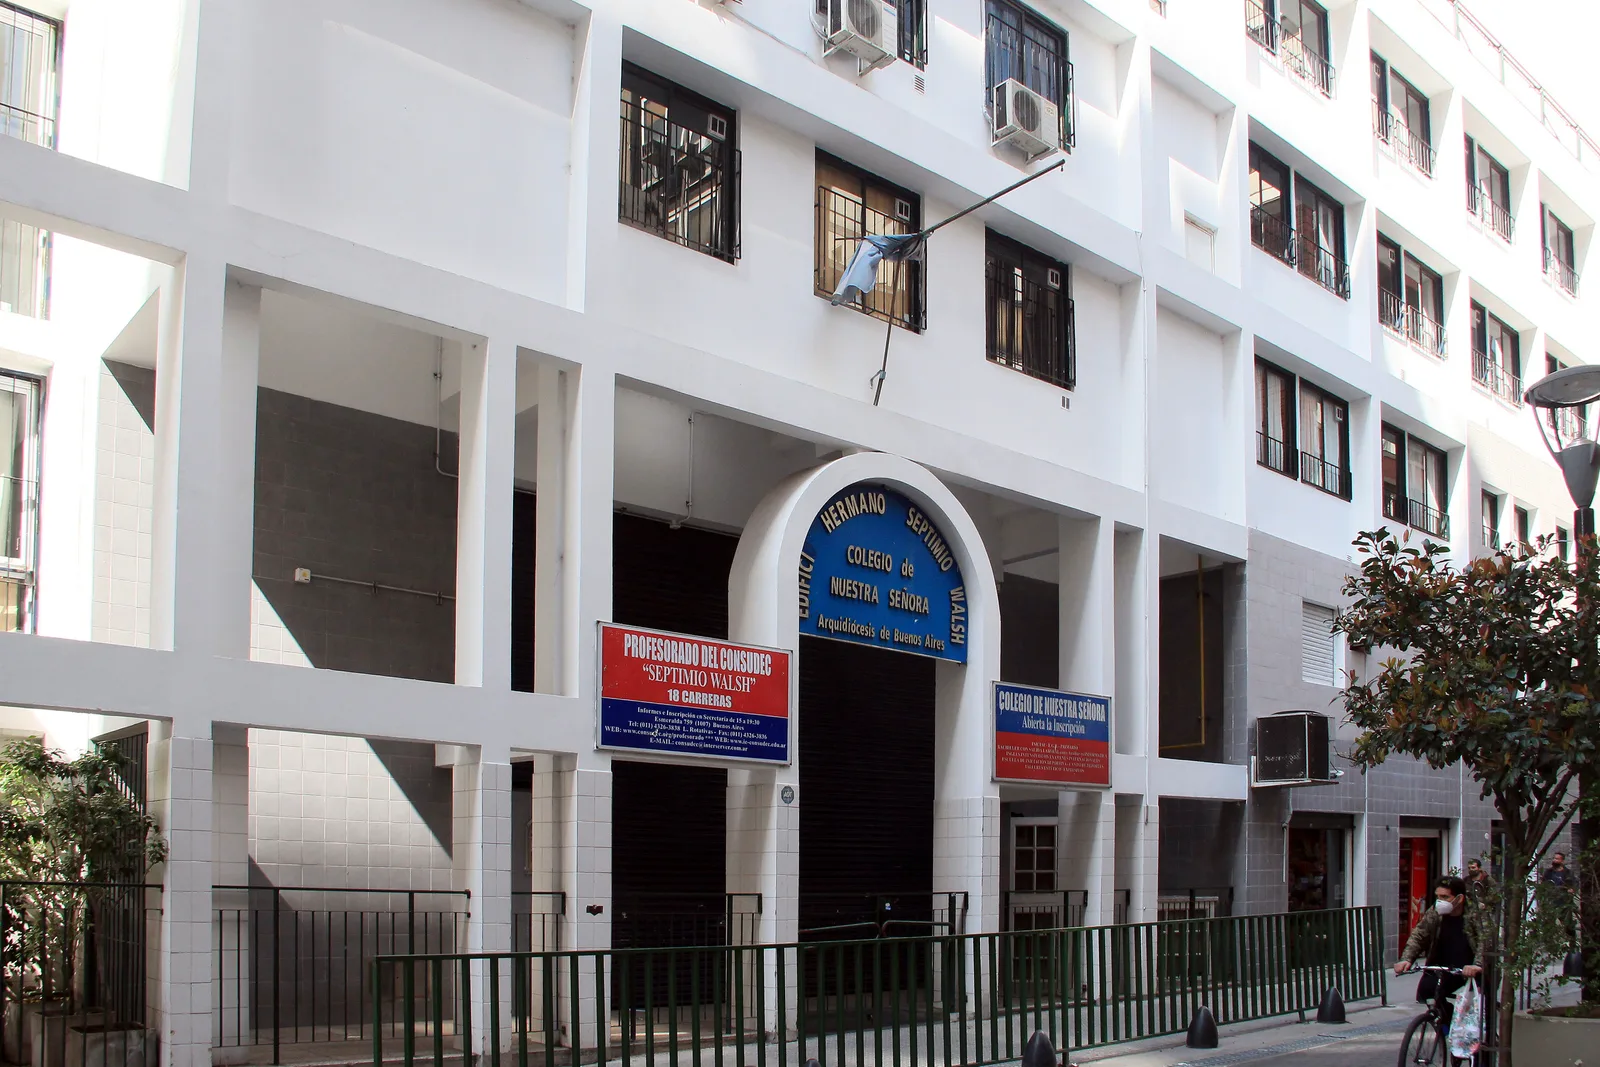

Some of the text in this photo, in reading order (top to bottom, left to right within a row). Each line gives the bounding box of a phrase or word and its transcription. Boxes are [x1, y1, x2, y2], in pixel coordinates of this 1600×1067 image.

[820, 492, 886, 534] HERMANO
[906, 507, 953, 572] SEPTIMIO
[950, 586, 966, 644] WALSH
[847, 545, 914, 578] COLEGIO de
[831, 576, 930, 614] NUESTRA SEÑORA
[818, 614, 946, 651] Arquidiócesis de Buenos Aires
[624, 633, 772, 676] PROFESORADO DEL CONSUDEC
[642, 664, 756, 692] “SEPTIMIO WALSH”
[637, 706, 661, 715] Informes
[668, 689, 732, 708] 18 CARRERAS
[999, 691, 1106, 722] COLEGIO DE NUESTRA SEÑORA
[654, 716, 683, 724] Esmeralda
[1022, 714, 1085, 736] Abierta la Inscripción
